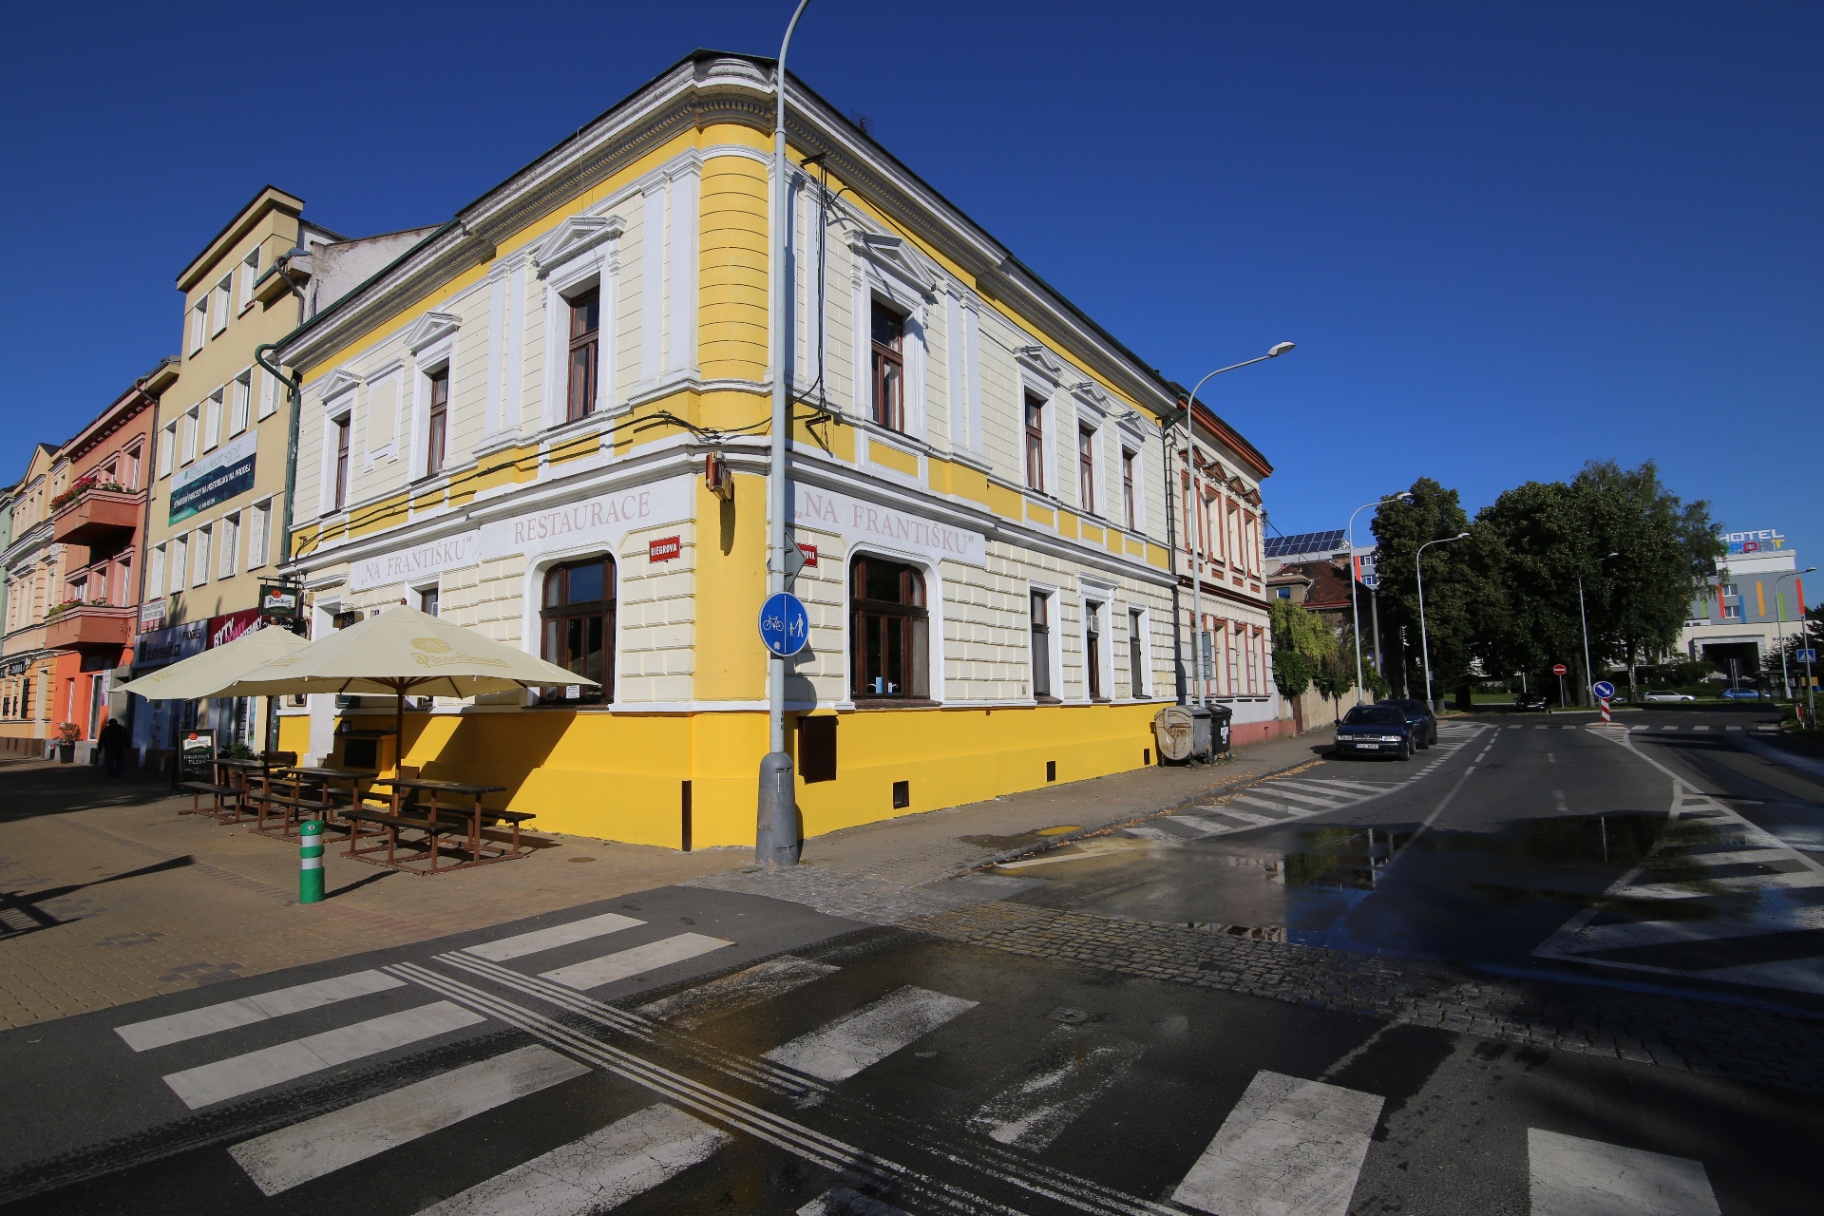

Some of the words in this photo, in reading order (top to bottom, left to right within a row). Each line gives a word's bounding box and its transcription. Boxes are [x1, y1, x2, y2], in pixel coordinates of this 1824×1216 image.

[514, 491, 651, 545] RESTAURACE
[1719, 529, 1785, 542] HOTEL
[650, 542, 677, 556] RIEGROVA
[1725, 539, 1785, 553] PORT
[213, 617, 235, 649] BYTY
[410, 652, 463, 669] Pilsner
[458, 652, 510, 668] Urquell
